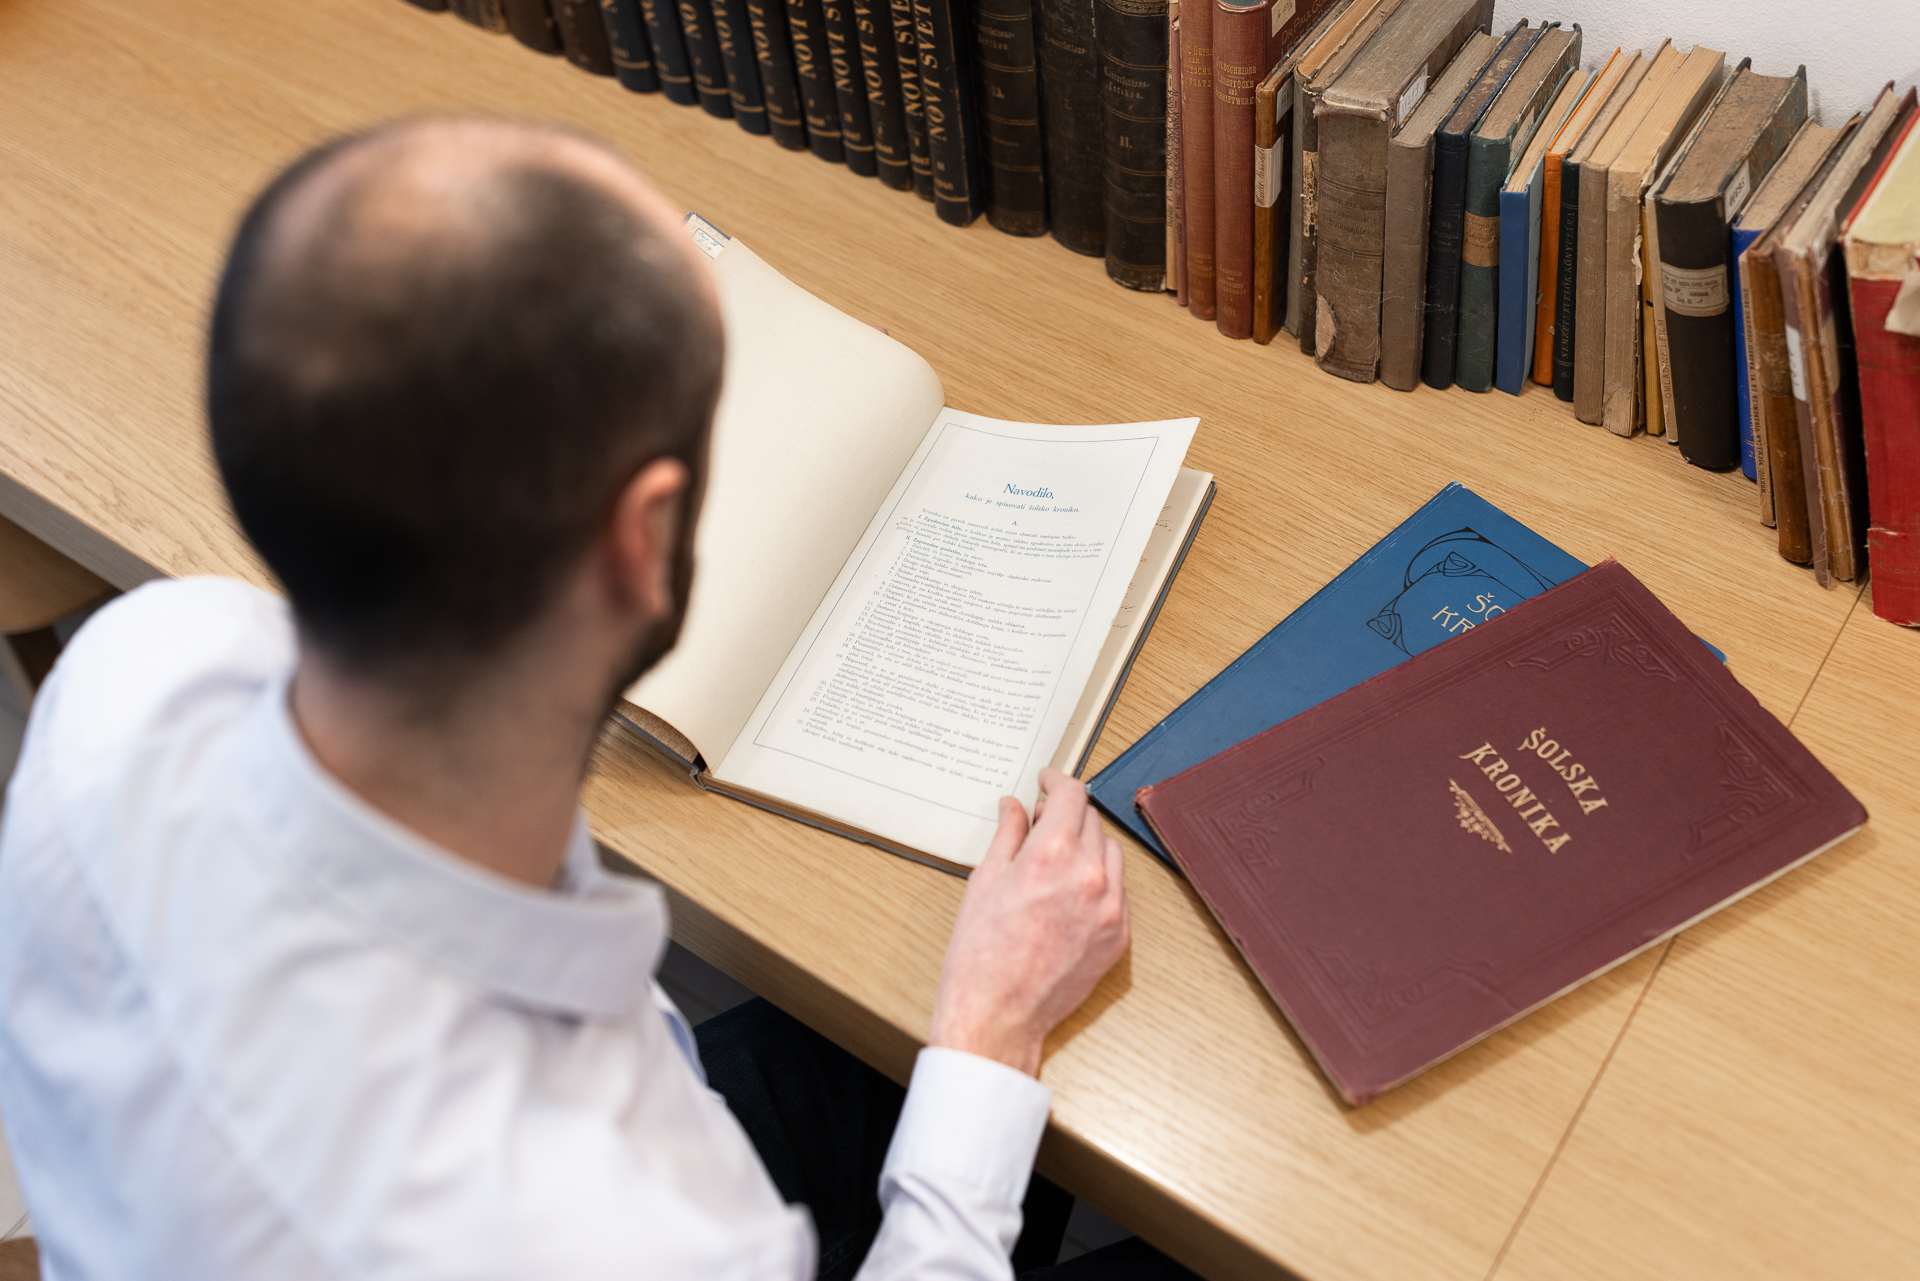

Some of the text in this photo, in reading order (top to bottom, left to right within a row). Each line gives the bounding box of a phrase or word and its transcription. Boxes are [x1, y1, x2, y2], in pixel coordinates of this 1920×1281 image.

[789, 17, 817, 79] NOVI
[826, 31, 854, 94] NOVI
[860, 42, 886, 106] NOVI
[914, 0, 947, 142] NOVI SVET
[898, 55, 924, 118] NOVI
[1657, 318, 1667, 342] FILM
[965, 492, 1080, 513] kako je spisovati šolsko kroniko.
[1003, 483, 1054, 499] Navodilo,
[1431, 604, 1477, 635] KR
[1466, 592, 1507, 622] ŠO
[1458, 742, 1573, 855] KRONIKA
[1516, 727, 1609, 816] ŠOLSKA
